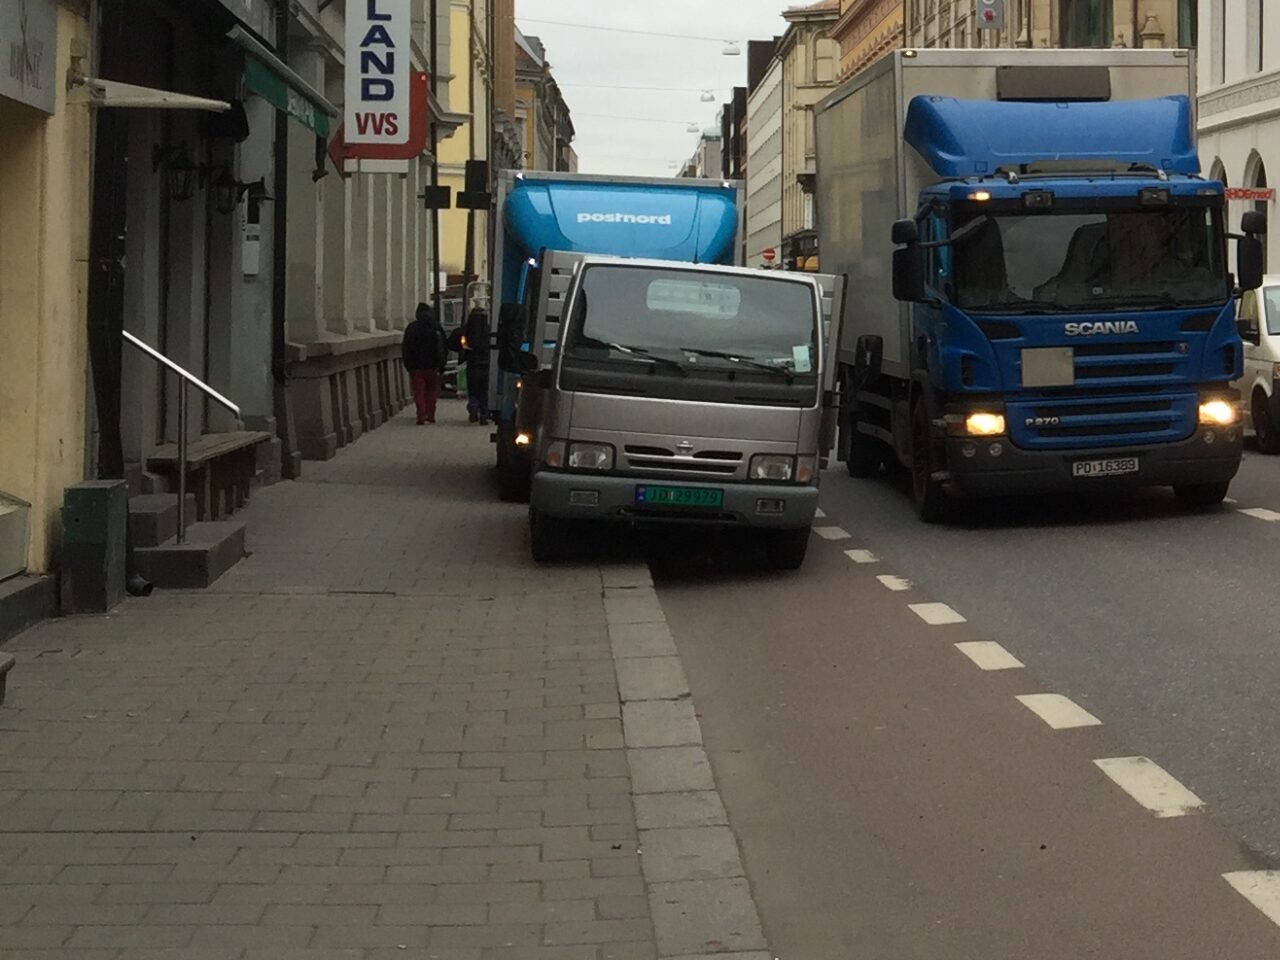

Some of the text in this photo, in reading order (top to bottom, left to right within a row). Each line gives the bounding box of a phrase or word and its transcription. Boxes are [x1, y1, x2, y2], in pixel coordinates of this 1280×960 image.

[355, 112, 398, 136] VVS
[577, 212, 671, 225] postnord
[1064, 321, 1139, 335] SCANIA
[1025, 417, 1059, 426] P 270
